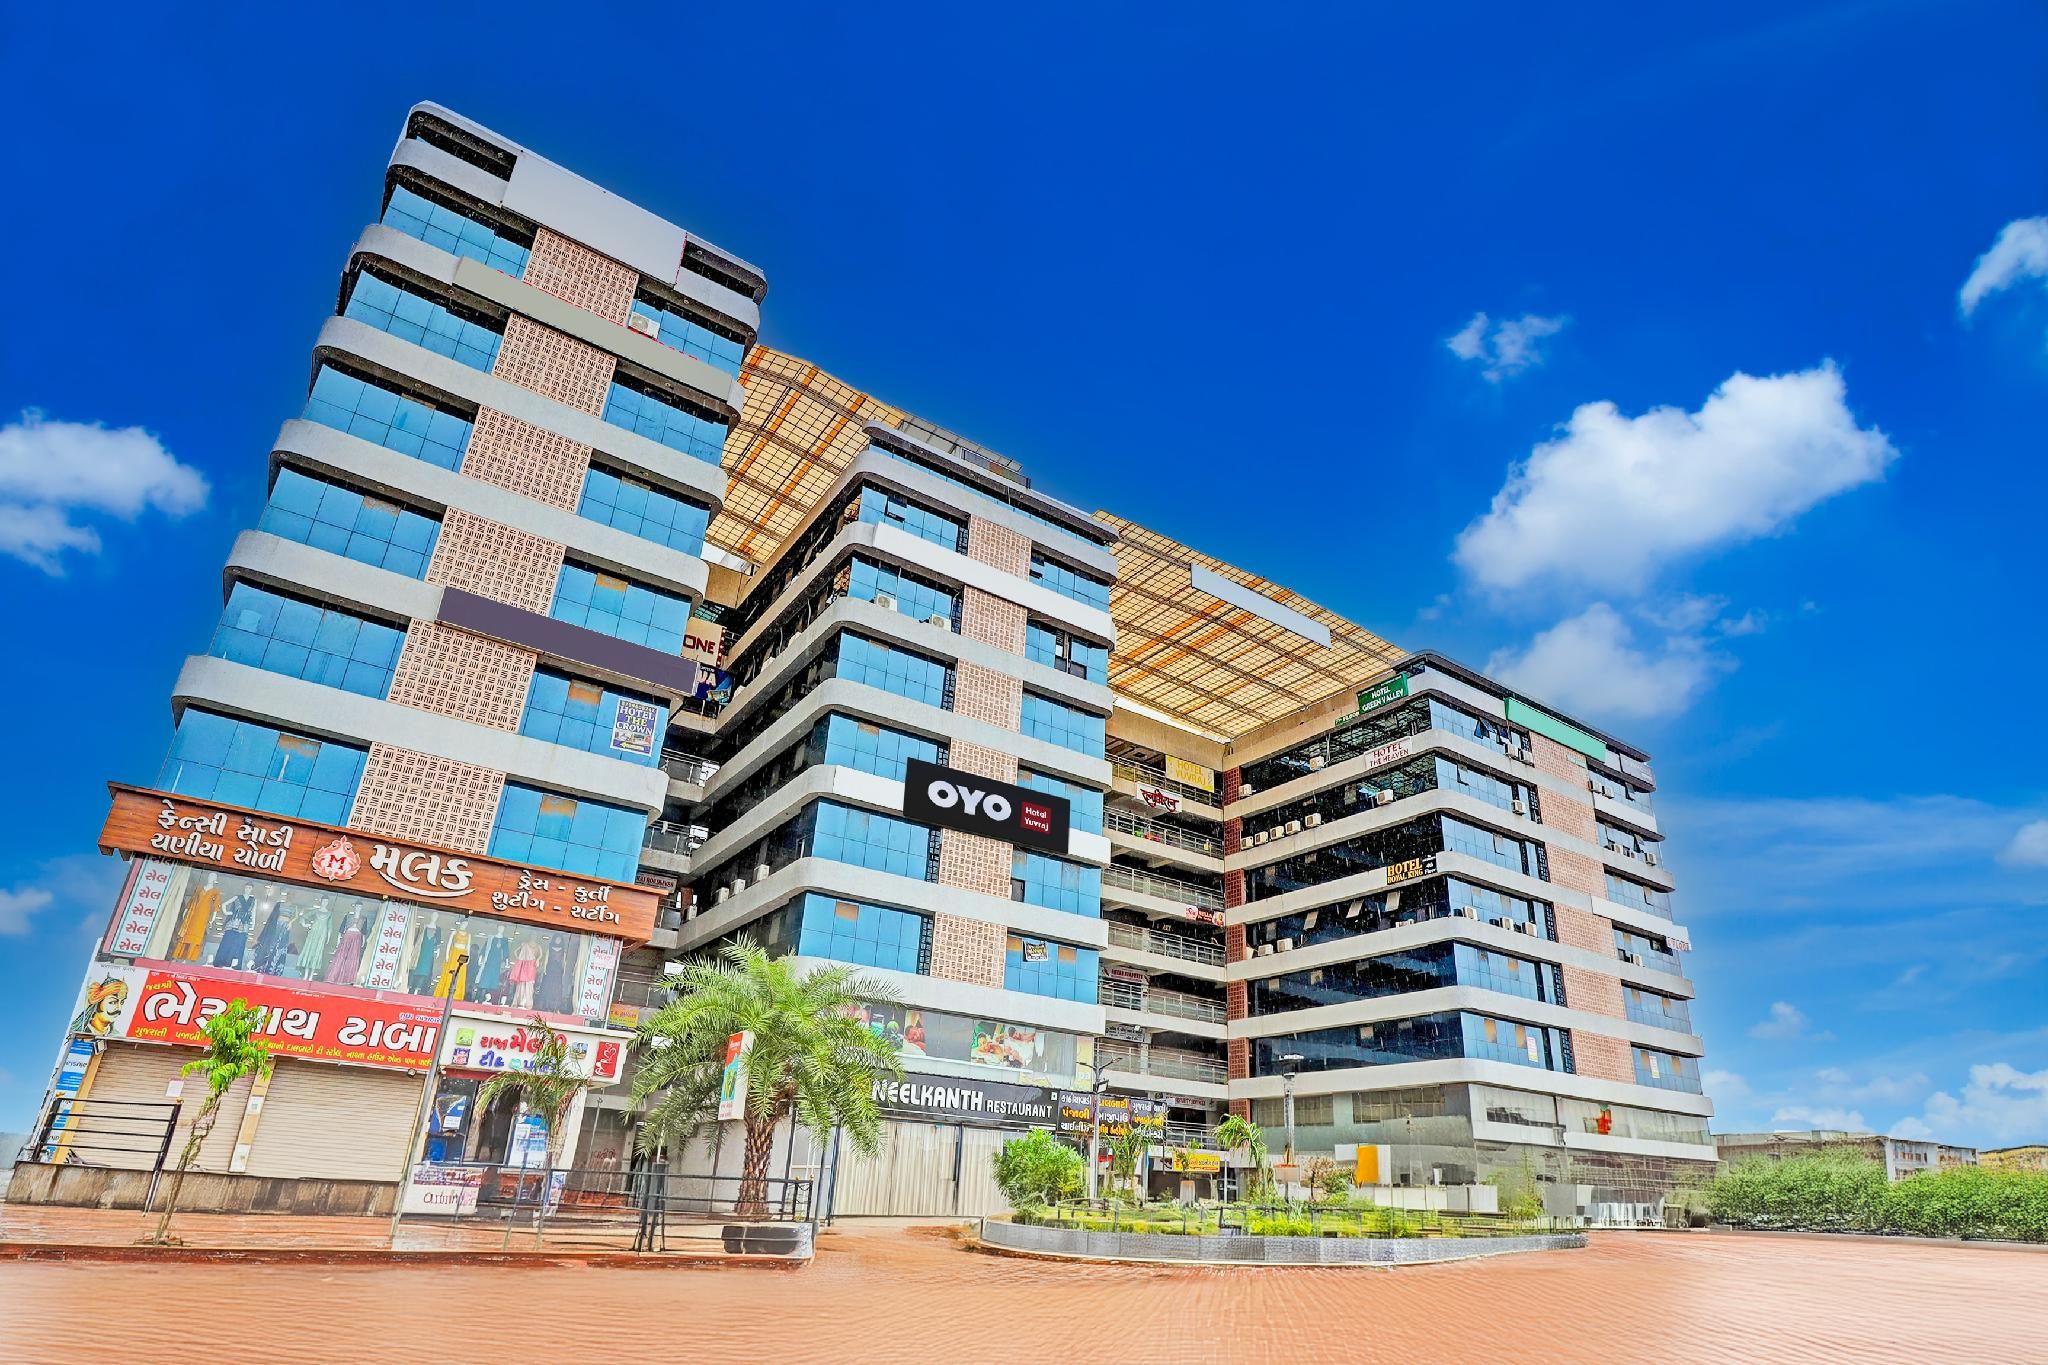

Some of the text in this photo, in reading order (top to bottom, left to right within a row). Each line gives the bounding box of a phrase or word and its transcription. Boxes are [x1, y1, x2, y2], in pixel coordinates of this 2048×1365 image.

[683, 634, 715, 654] ONE
[1362, 688, 1404, 712] GREEN VALLEY
[1372, 686, 1391, 699] HOTEL
[620, 706, 655, 721] HOTEL
[626, 714, 648, 727] THE
[616, 721, 653, 736] CROWN
[1373, 743, 1402, 758] HOTEL
[1370, 749, 1409, 768] THE HEAVEN
[1177, 761, 1202, 776] HOTEL
[928, 780, 1012, 822] OYO
[157, 800, 229, 837] ફેન્સી
[1025, 806, 1047, 819] Hotel
[1024, 817, 1049, 832] Yuvraj
[328, 854, 346, 869] M
[1387, 858, 1422, 876] HOTEL
[1387, 868, 1424, 884] ROYAL KING
[337, 1016, 438, 1054] ઢાબા
[872, 1079, 1053, 1118] NEELKANTH RESTAURANT
